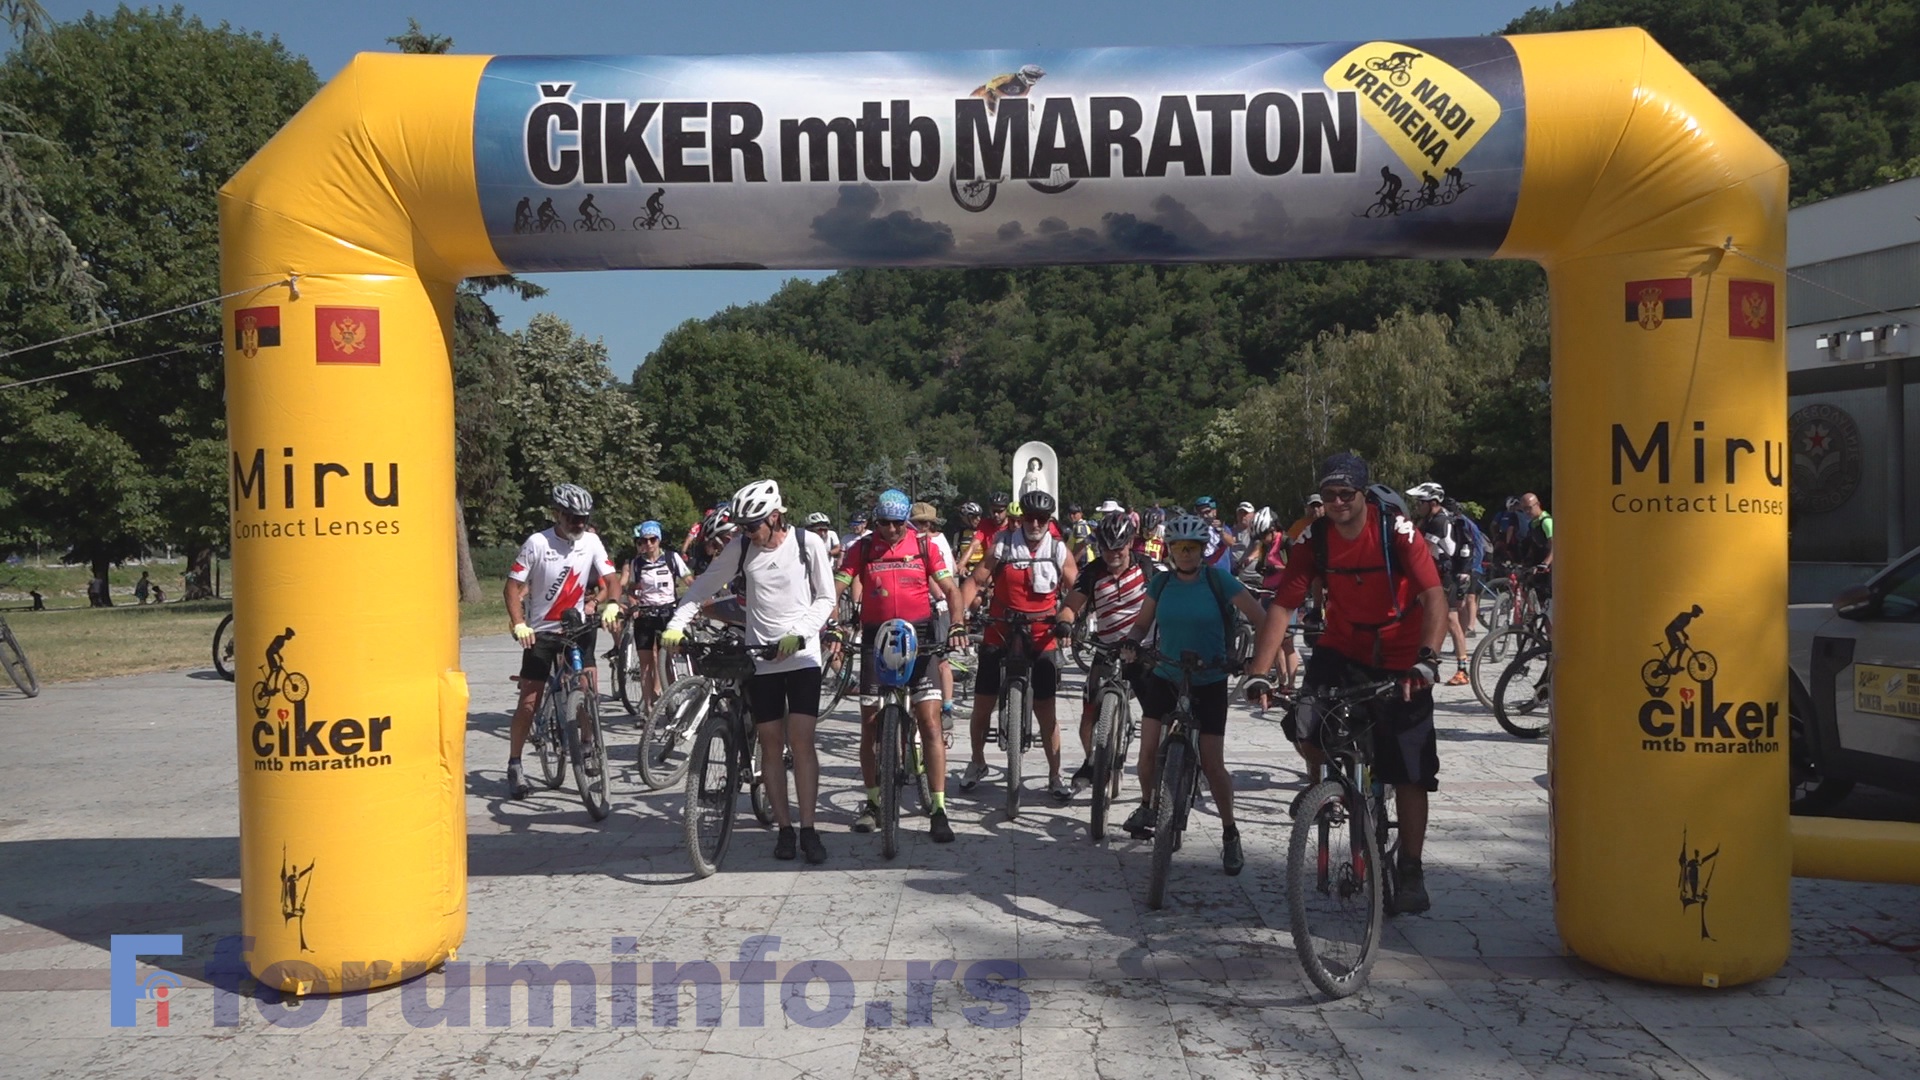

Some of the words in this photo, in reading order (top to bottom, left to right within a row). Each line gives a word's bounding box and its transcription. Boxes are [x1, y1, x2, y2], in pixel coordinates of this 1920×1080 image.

[527, 83, 768, 185] ČIKER
[780, 99, 941, 182] mtb
[955, 91, 1358, 182] MARATON
[1343, 62, 1450, 167] VREMENA
[1411, 77, 1476, 140] NAĐI
[233, 446, 400, 511] Miru
[1611, 421, 1783, 487] Miru
[234, 518, 306, 539] Contact
[314, 516, 400, 537] Lenses
[1611, 493, 1717, 514] Contact
[1725, 493, 1784, 516] Lenses
[254, 757, 284, 771] mtb
[289, 753, 392, 772] marathon
[1641, 737, 1687, 752] mtb
[1694, 738, 1779, 754] marathon
